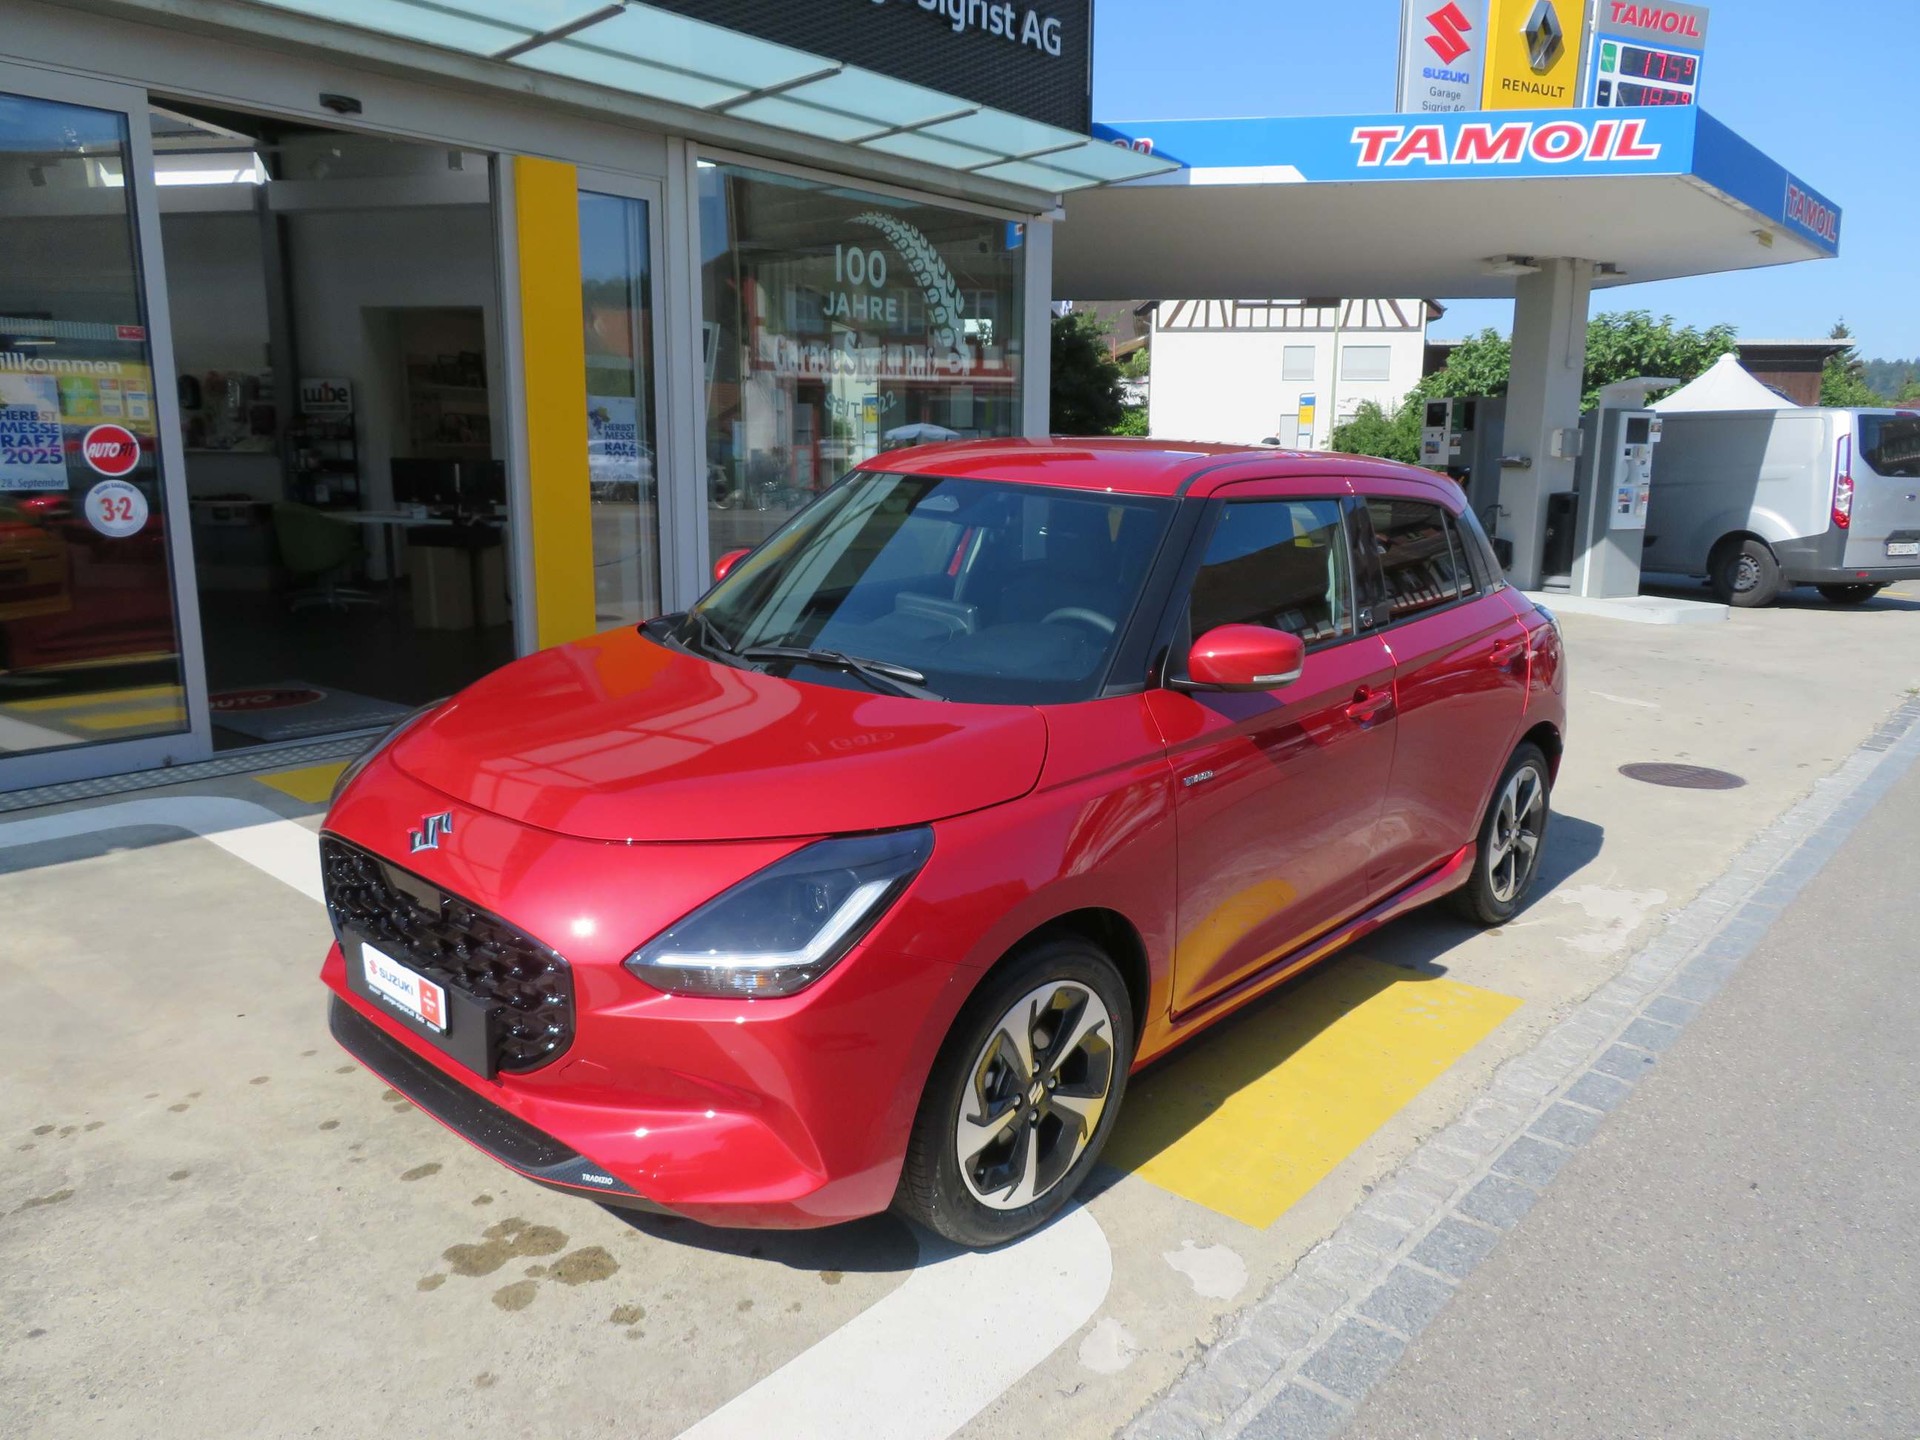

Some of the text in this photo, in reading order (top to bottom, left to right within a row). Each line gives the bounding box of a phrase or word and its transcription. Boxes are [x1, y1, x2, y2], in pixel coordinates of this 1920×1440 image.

[1610, 1, 1701, 38] TAMOIL
[1021, 9, 1062, 56] AG
[1422, 67, 1470, 85] SUZUKI
[1429, 86, 1462, 101] Garage
[1501, 77, 1566, 98] RENAULT
[1350, 118, 1663, 167] TAMOIL
[1787, 183, 1837, 243] TAMOIL
[835, 243, 887, 288] 100
[823, 291, 898, 322] JAHRE
[824, 391, 861, 418] SEIT
[0, 410, 57, 421] HERBST
[0, 422, 60, 434] MESSE
[604, 423, 636, 432] HERBST
[604, 431, 637, 441] MESSE
[1, 435, 61, 448] RAFZ
[2, 448, 63, 464] 2025
[19, 479, 65, 489] September
[379, 967, 414, 995] SUZUKI
